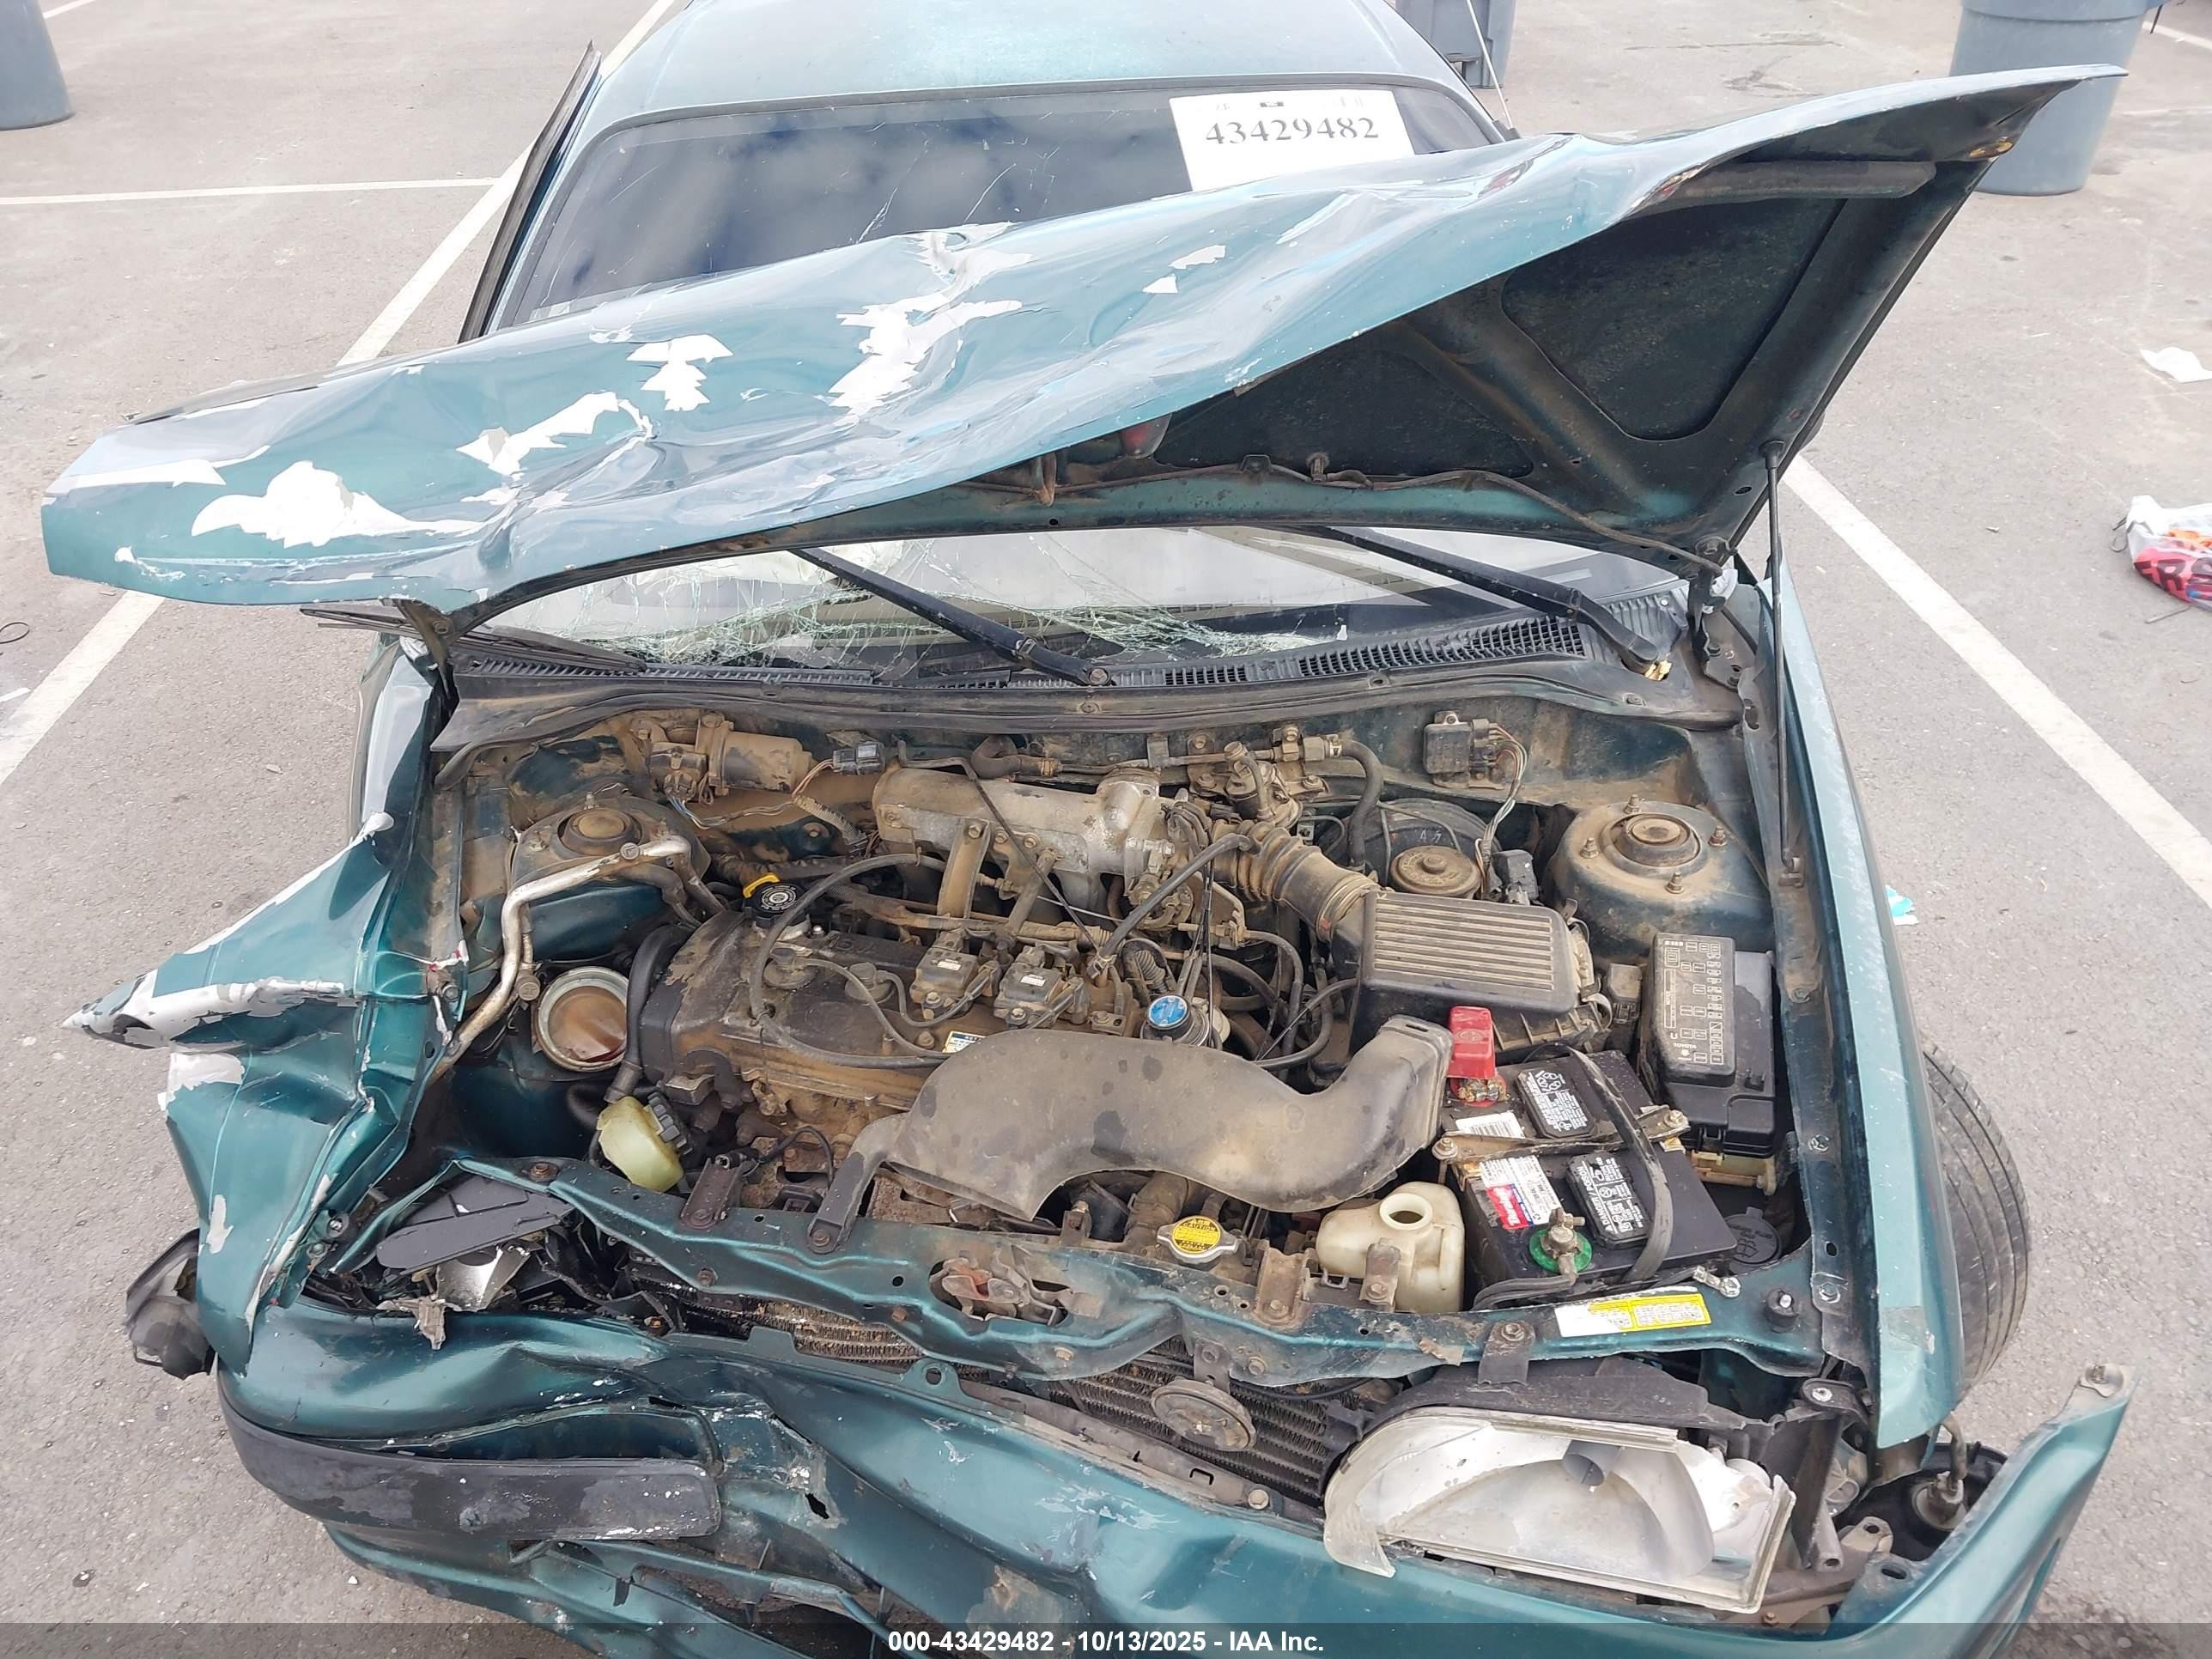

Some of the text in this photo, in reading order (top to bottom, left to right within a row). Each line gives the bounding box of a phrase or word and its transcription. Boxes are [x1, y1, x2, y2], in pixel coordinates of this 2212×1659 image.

[1205, 117, 1380, 145] 43429482
[1577, 1166, 1594, 1192] POISON
[1591, 1197, 1610, 1225] DANGER
